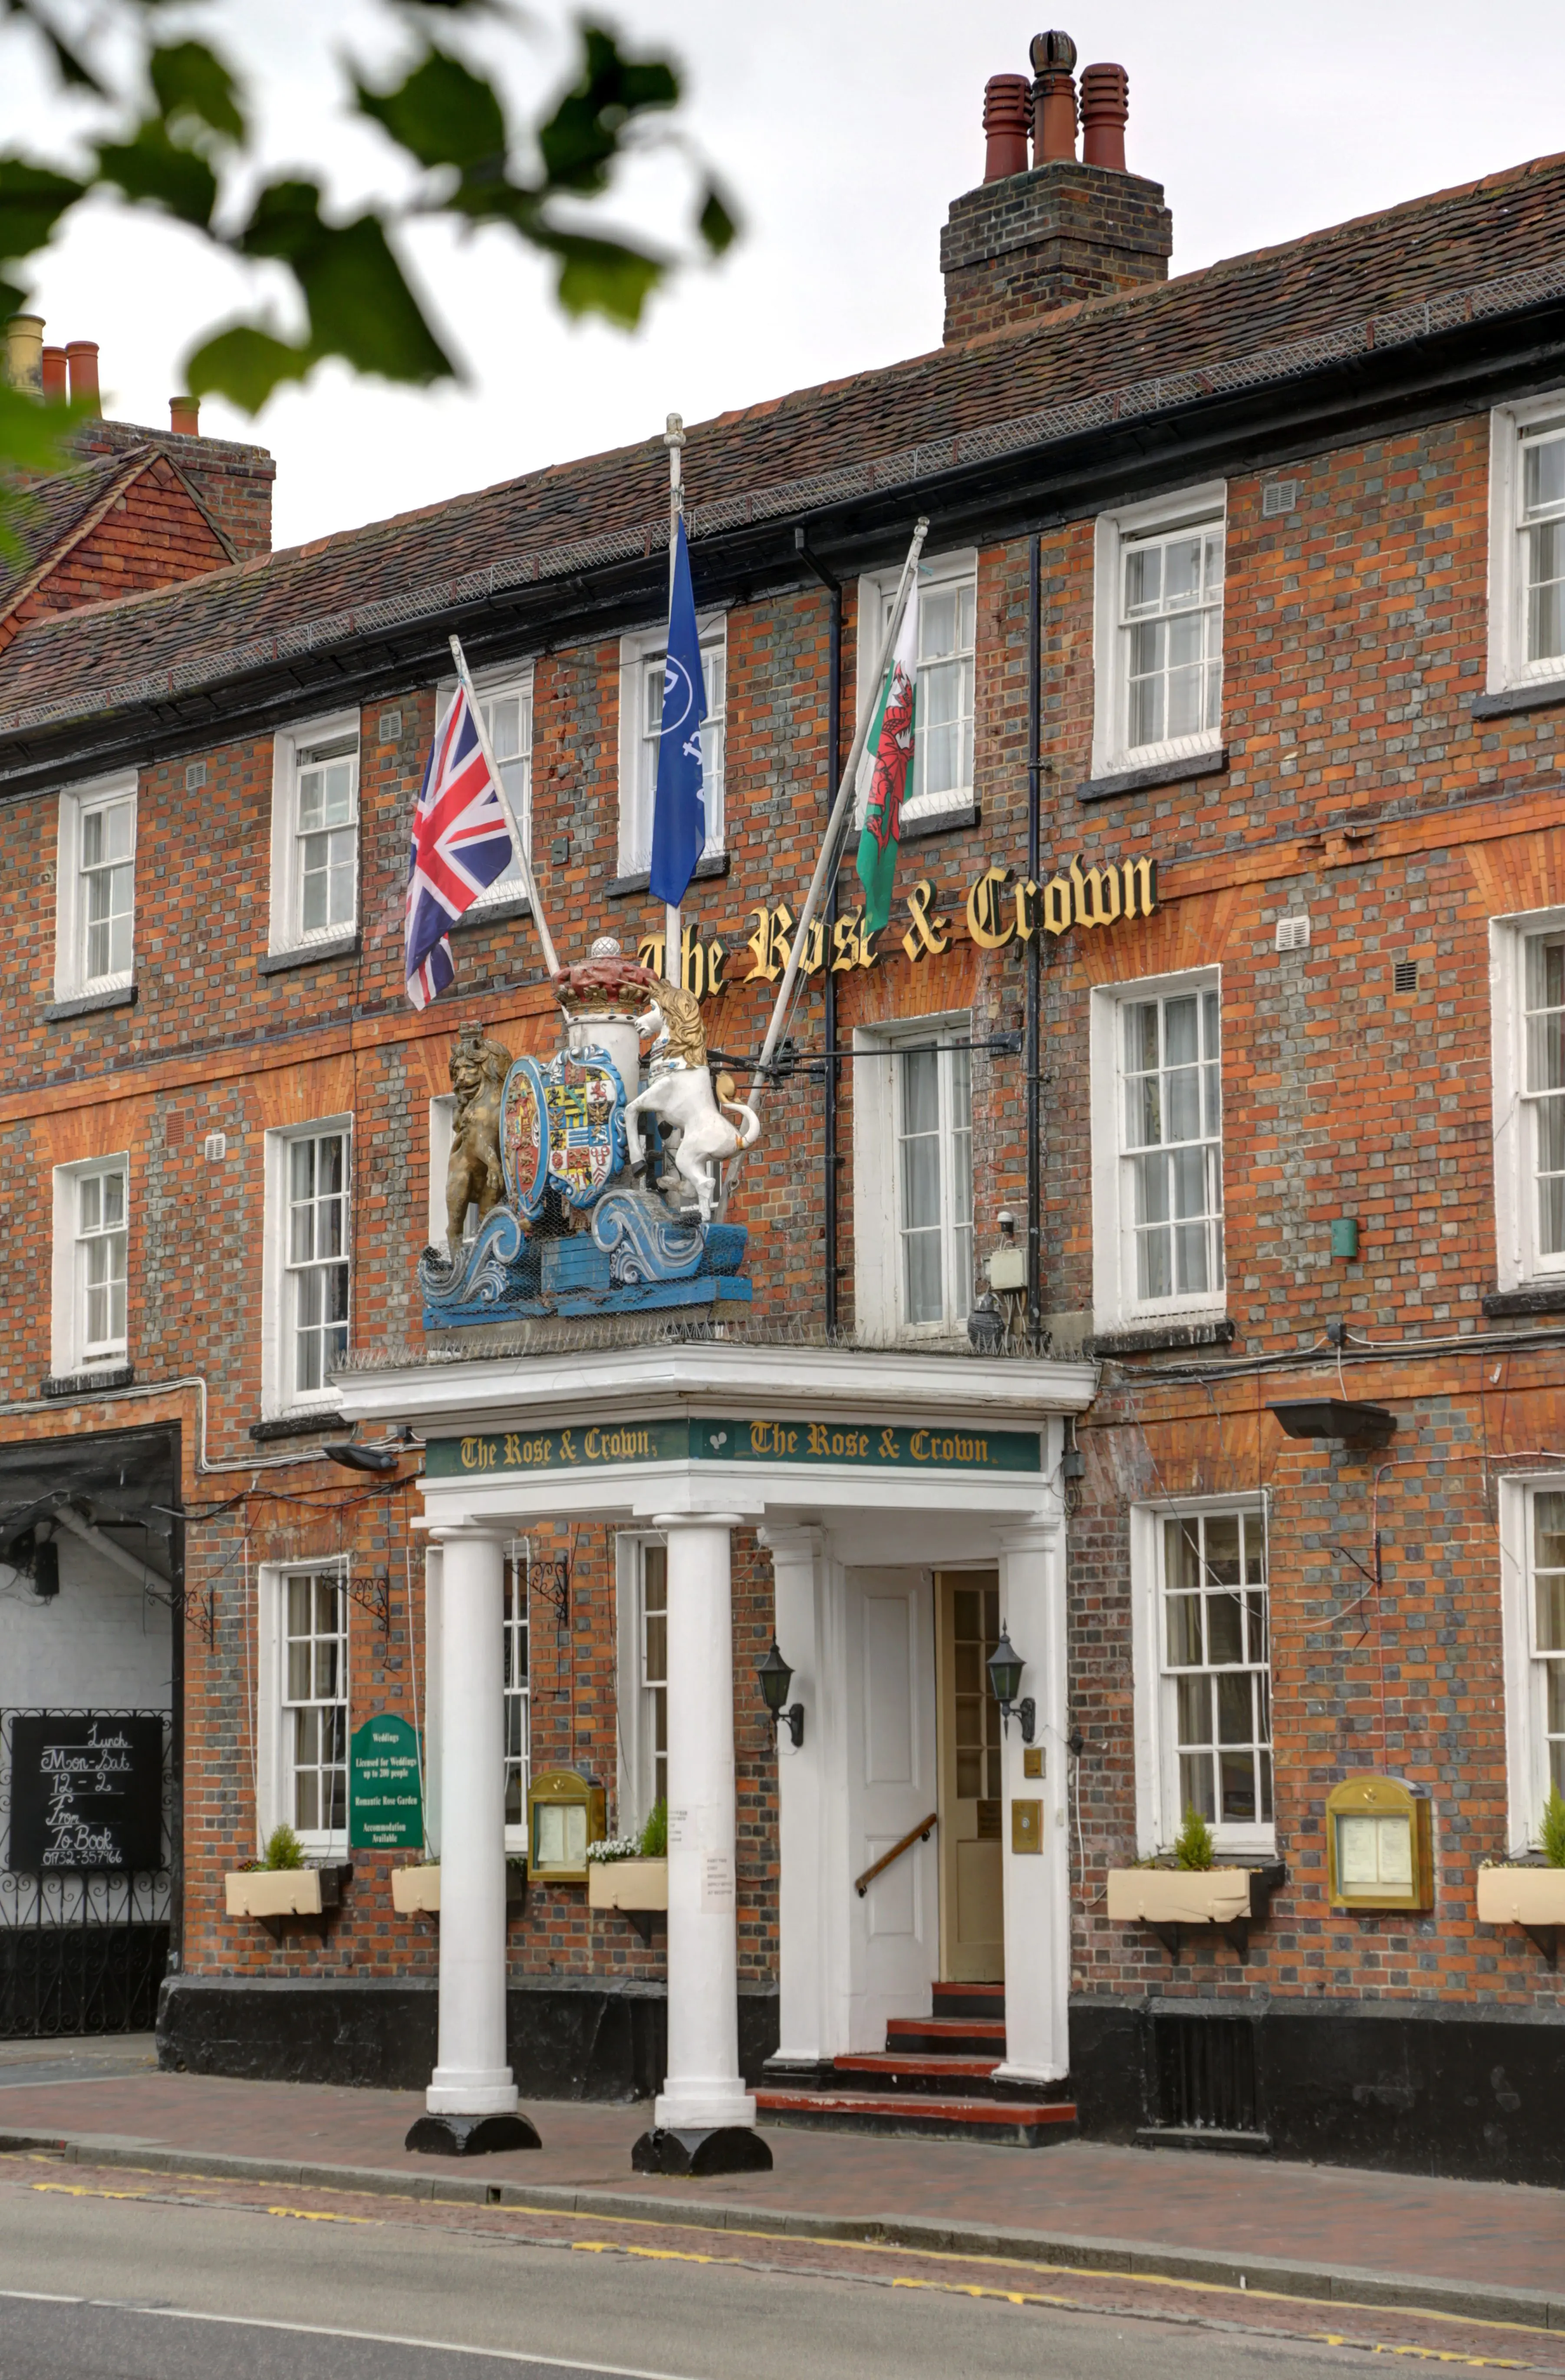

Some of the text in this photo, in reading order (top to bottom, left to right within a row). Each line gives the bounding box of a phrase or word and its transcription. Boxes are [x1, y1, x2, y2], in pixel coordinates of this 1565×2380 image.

[743, 902, 886, 984] Rose
[902, 879, 952, 963] &
[966, 854, 1159, 949] Crown
[461, 1427, 649, 1470] The Rose & Crown
[749, 1421, 988, 1462] The Rose & Crown
[87, 1721, 128, 1748] Lunch
[373, 1734, 399, 1743] Weddings
[356, 1757, 417, 1768] Licensed for Weddings
[53, 1773, 73, 1793] 12
[95, 1772, 111, 1791] 2
[363, 1771, 370, 1779] up
[372, 1770, 378, 1778] to
[391, 1768, 409, 1779] people
[46, 1794, 80, 1825] From
[355, 1795, 417, 1806] Romantic Rose Garden
[363, 1822, 406, 1831] Accommodation
[51, 1825, 112, 1850] To Book
[372, 1834, 397, 1843] Available
